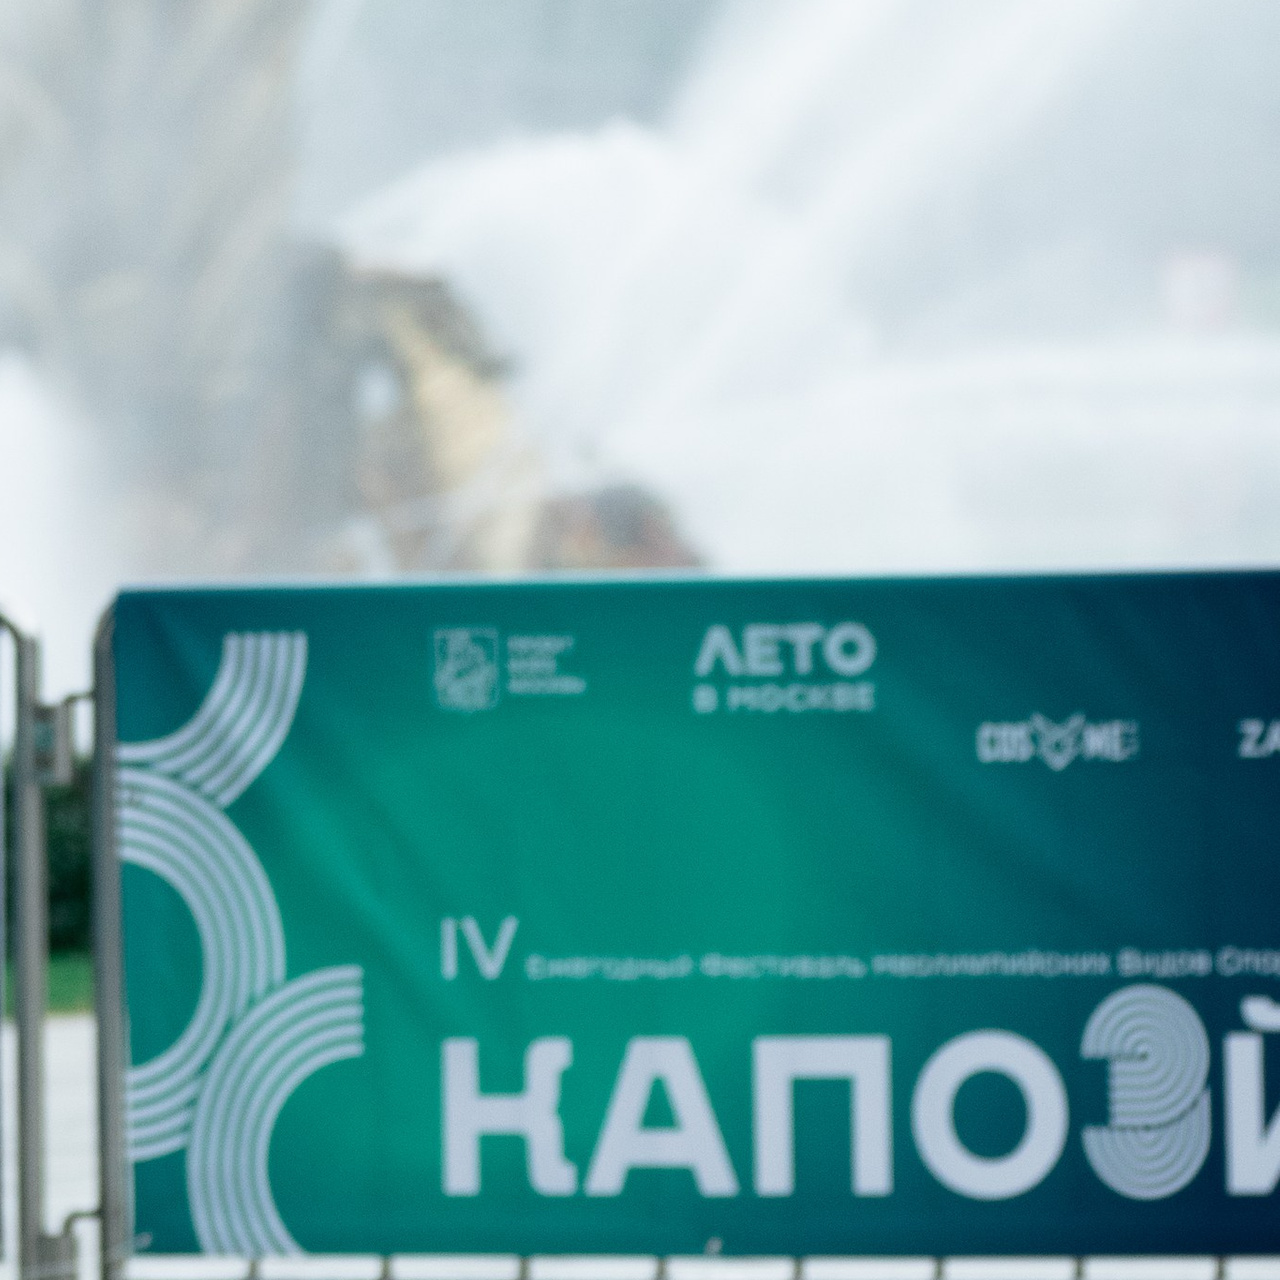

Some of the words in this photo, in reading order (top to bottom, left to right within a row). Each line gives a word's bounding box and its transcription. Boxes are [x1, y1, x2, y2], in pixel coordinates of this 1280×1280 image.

[694, 622, 877, 677] ЛЕТО
[693, 685, 718, 714] В
[726, 682, 875, 714] МОСКВЕ
[440, 915, 519, 981] IV
